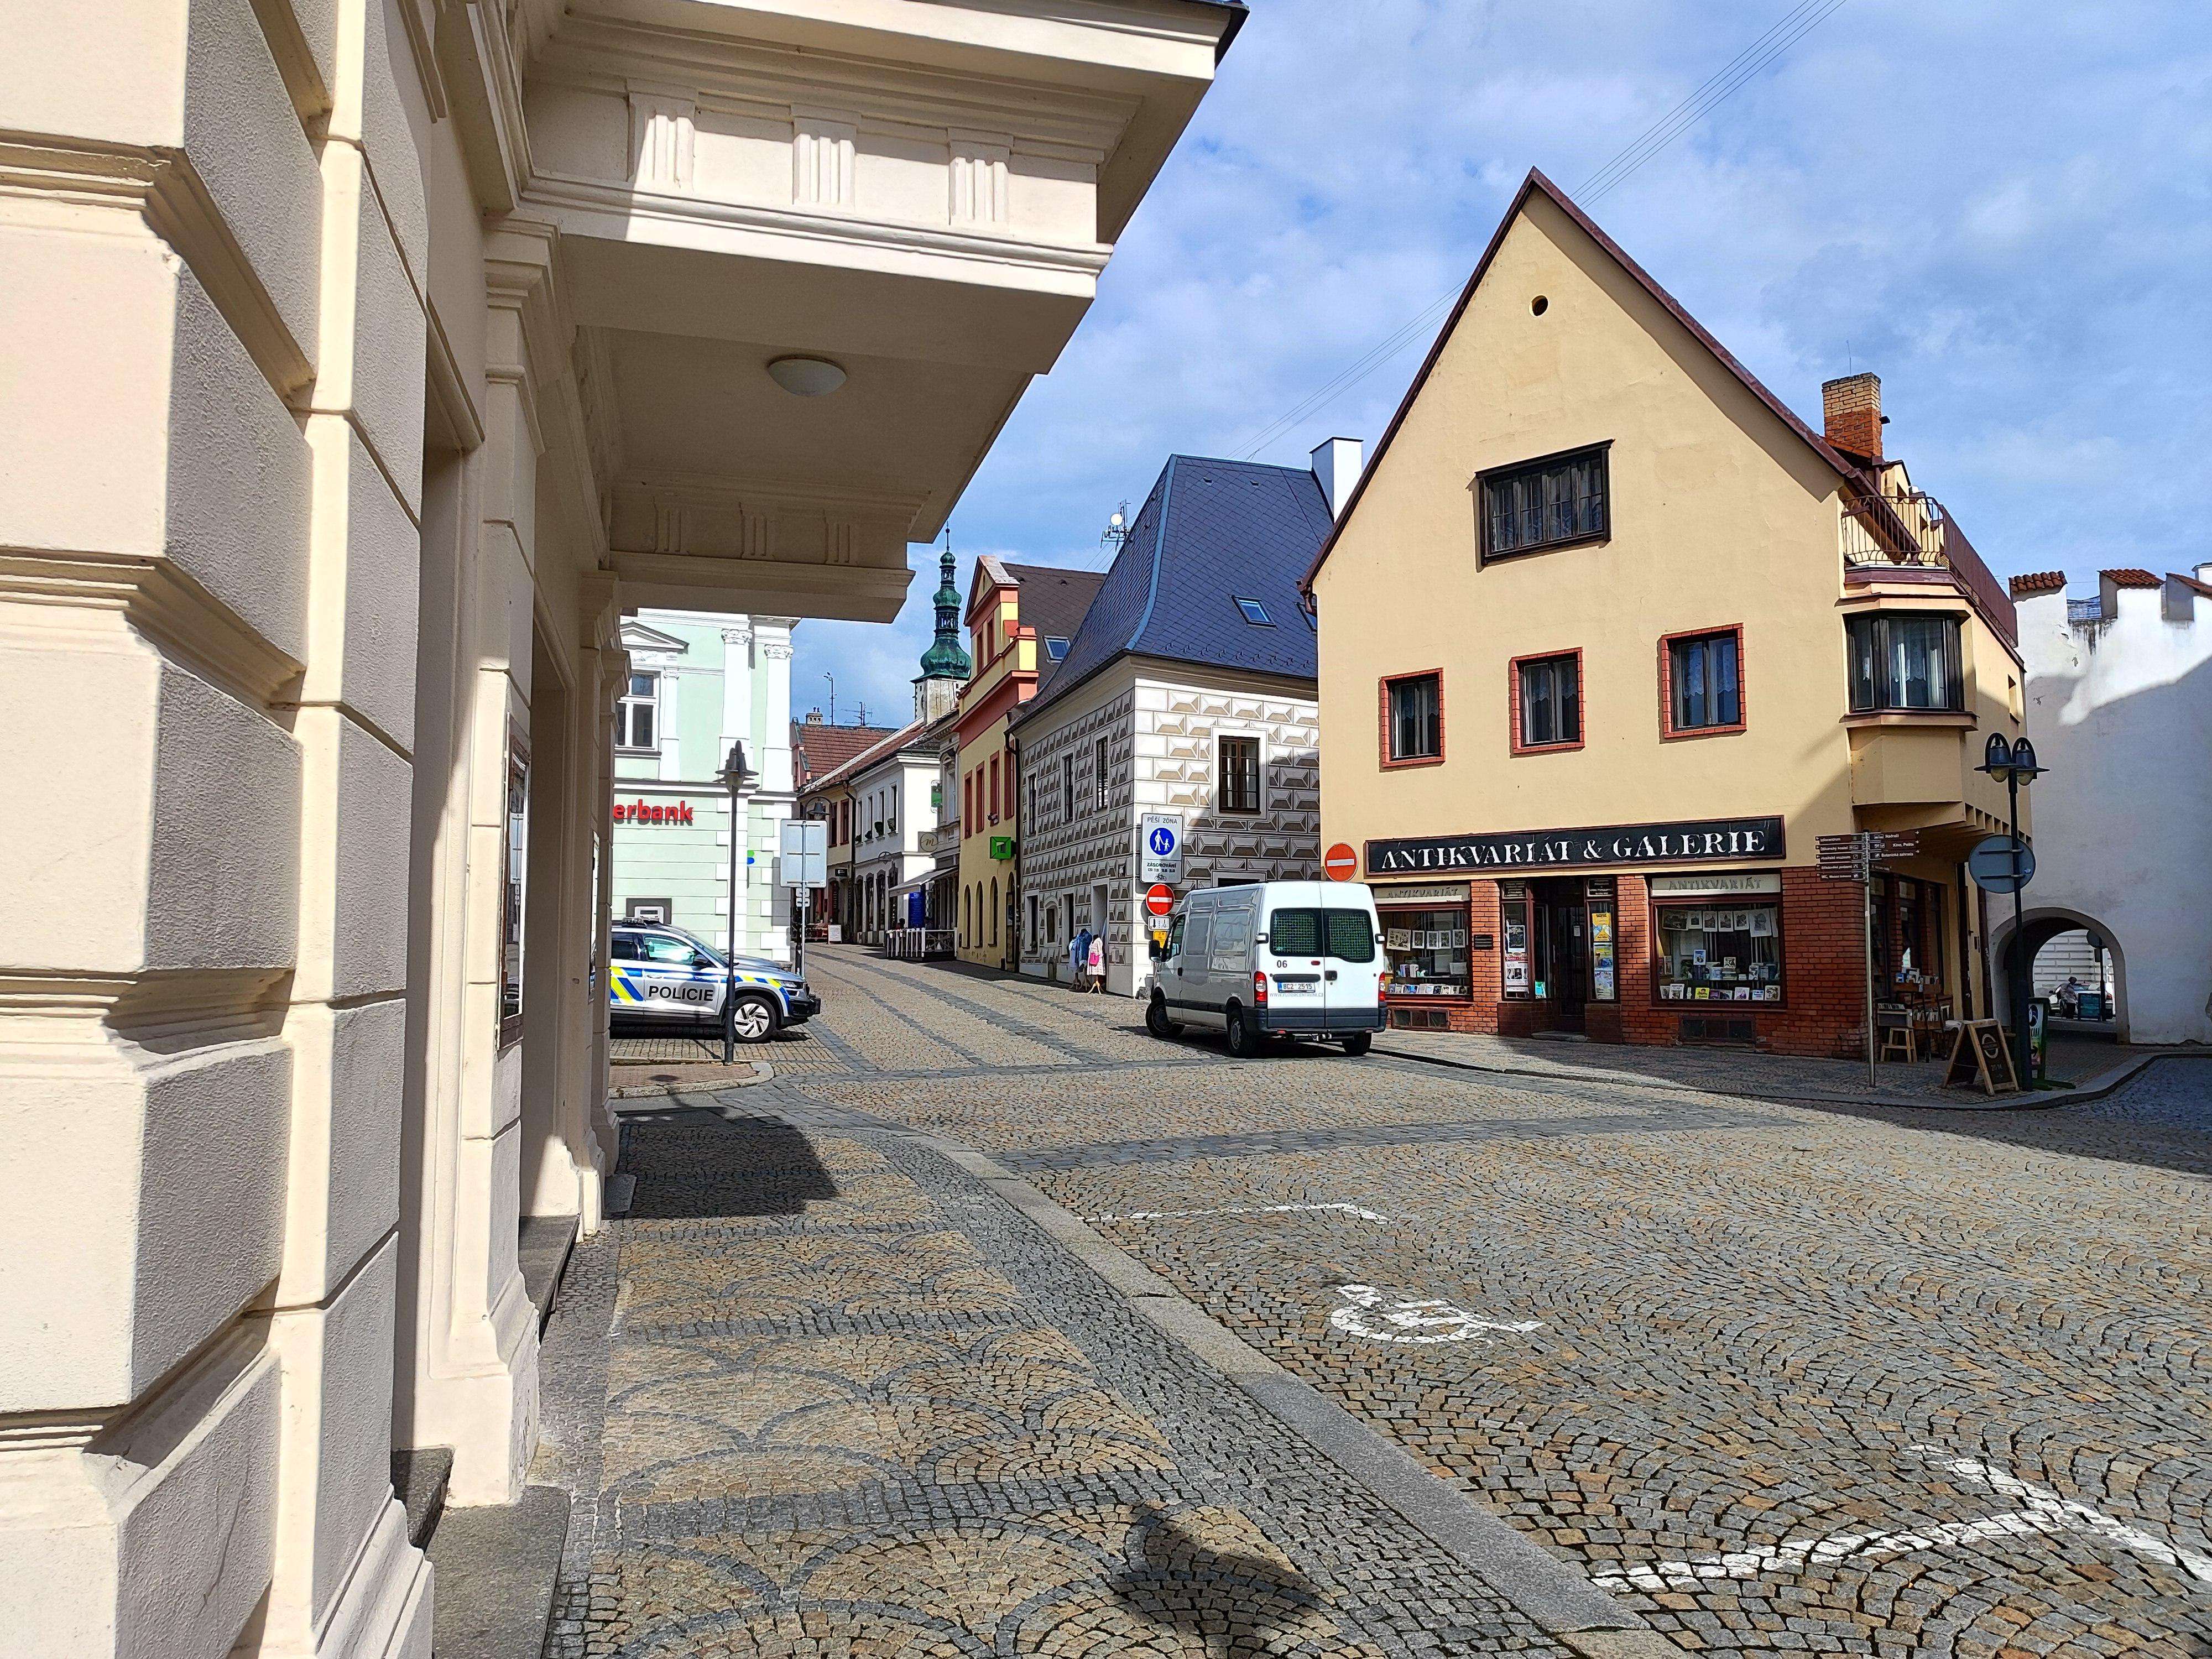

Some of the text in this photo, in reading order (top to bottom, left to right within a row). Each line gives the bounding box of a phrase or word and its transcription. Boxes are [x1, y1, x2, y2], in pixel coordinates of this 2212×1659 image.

[613, 799, 694, 821] erbank
[1381, 830, 1765, 869] ANTIKVARIÁT & GALERIE
[1668, 877, 1761, 890] ANTIKVARIÁT
[1388, 886, 1458, 898] ANTIKVARIÁT
[1276, 960, 1288, 968] 06
[648, 985, 714, 1002] POLICIE
